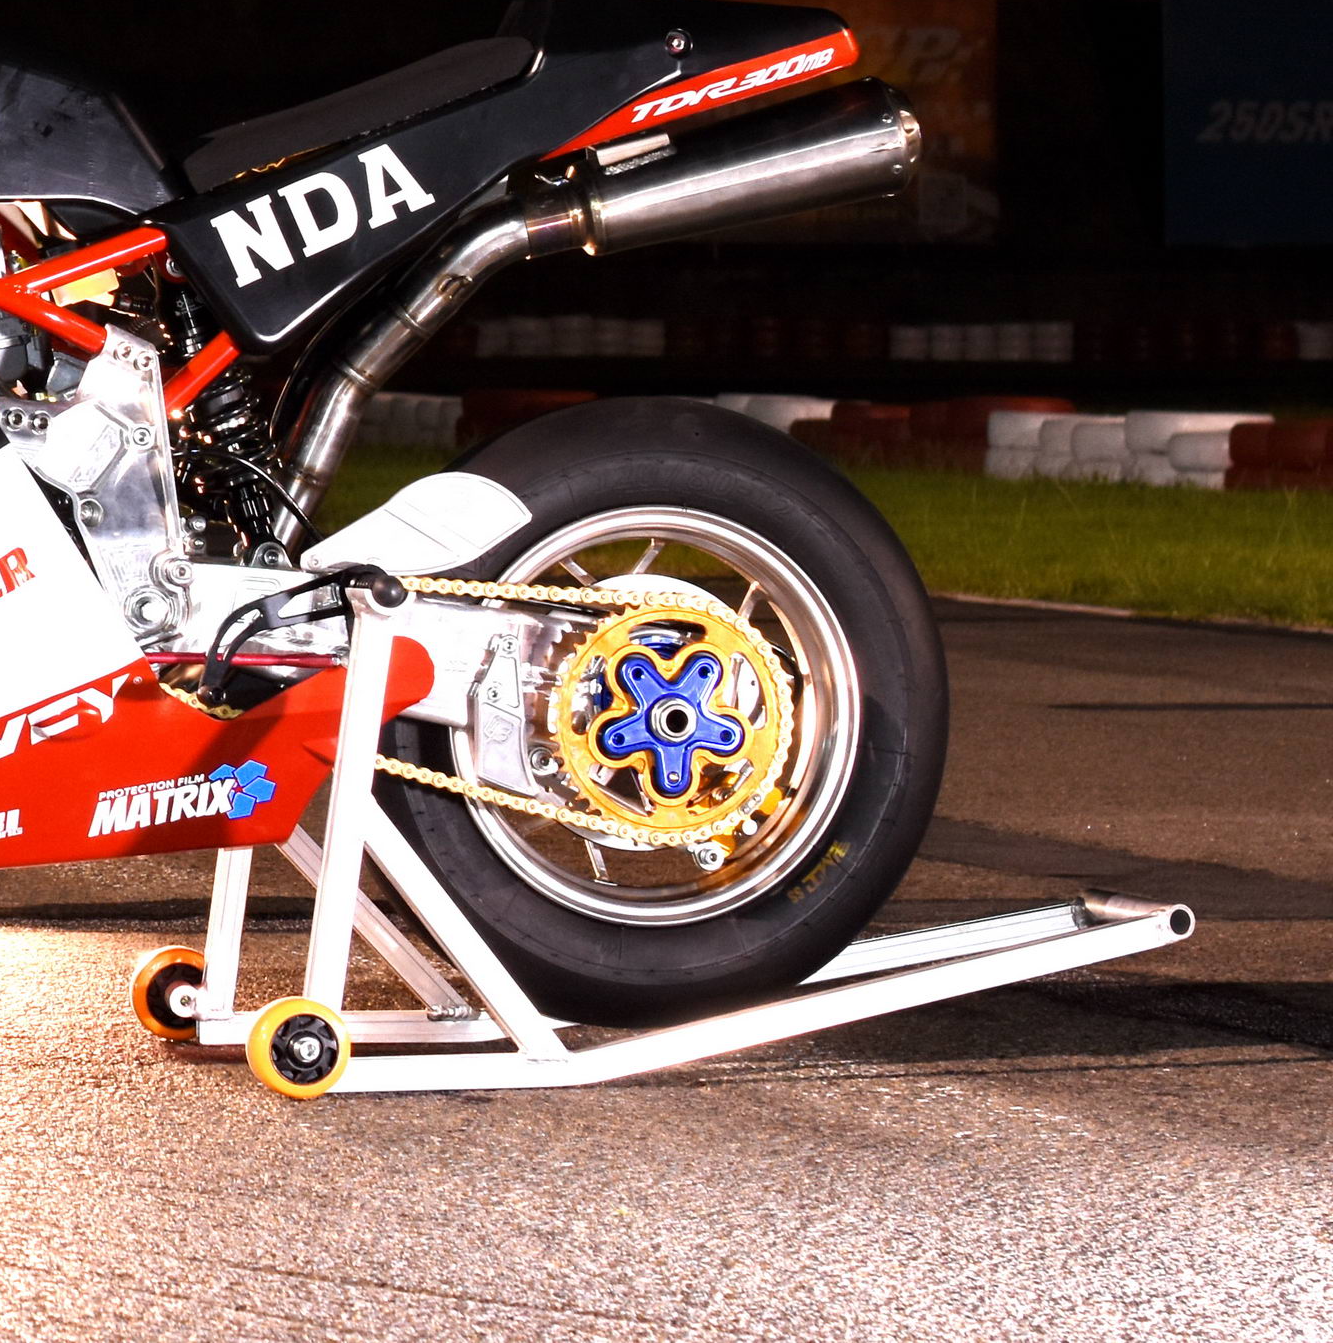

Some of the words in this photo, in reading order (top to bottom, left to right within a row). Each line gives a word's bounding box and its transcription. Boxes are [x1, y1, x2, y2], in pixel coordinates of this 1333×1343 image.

[210, 144, 435, 288] NDA
[87, 777, 236, 838] MATRIX
[98, 780, 175, 801] PROTECTION
[177, 773, 205, 789] FILM
